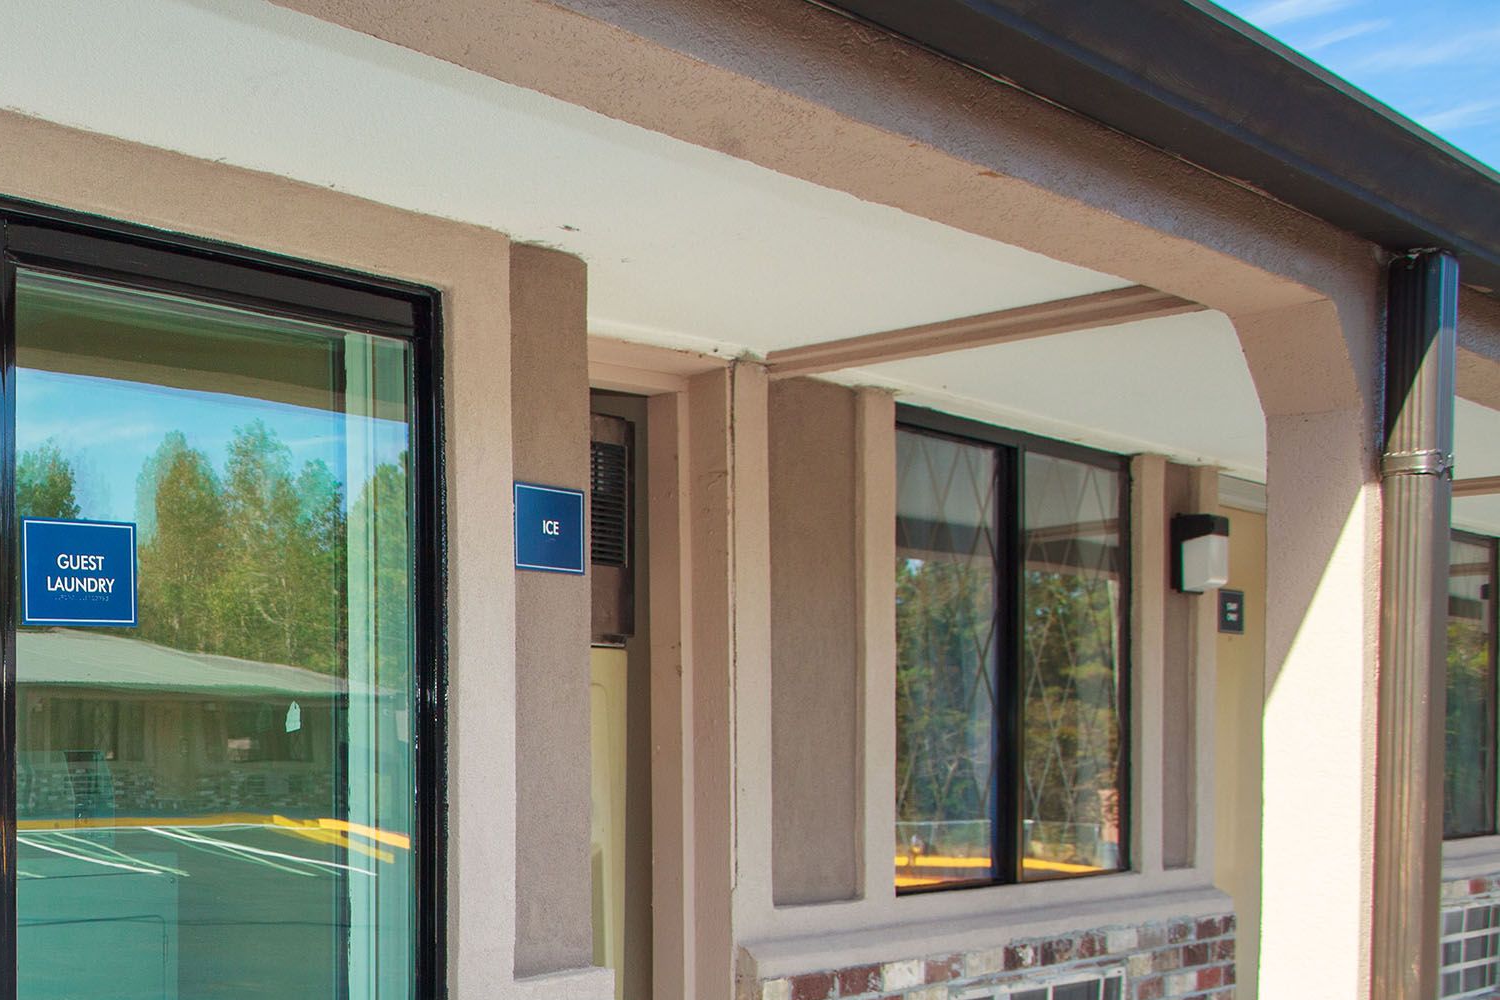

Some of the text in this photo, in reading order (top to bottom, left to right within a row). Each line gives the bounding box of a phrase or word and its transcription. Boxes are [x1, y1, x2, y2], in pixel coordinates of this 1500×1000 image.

[542, 520, 560, 535] ICE
[57, 554, 105, 570] GUEST
[46, 576, 115, 593] LAUNDRY
